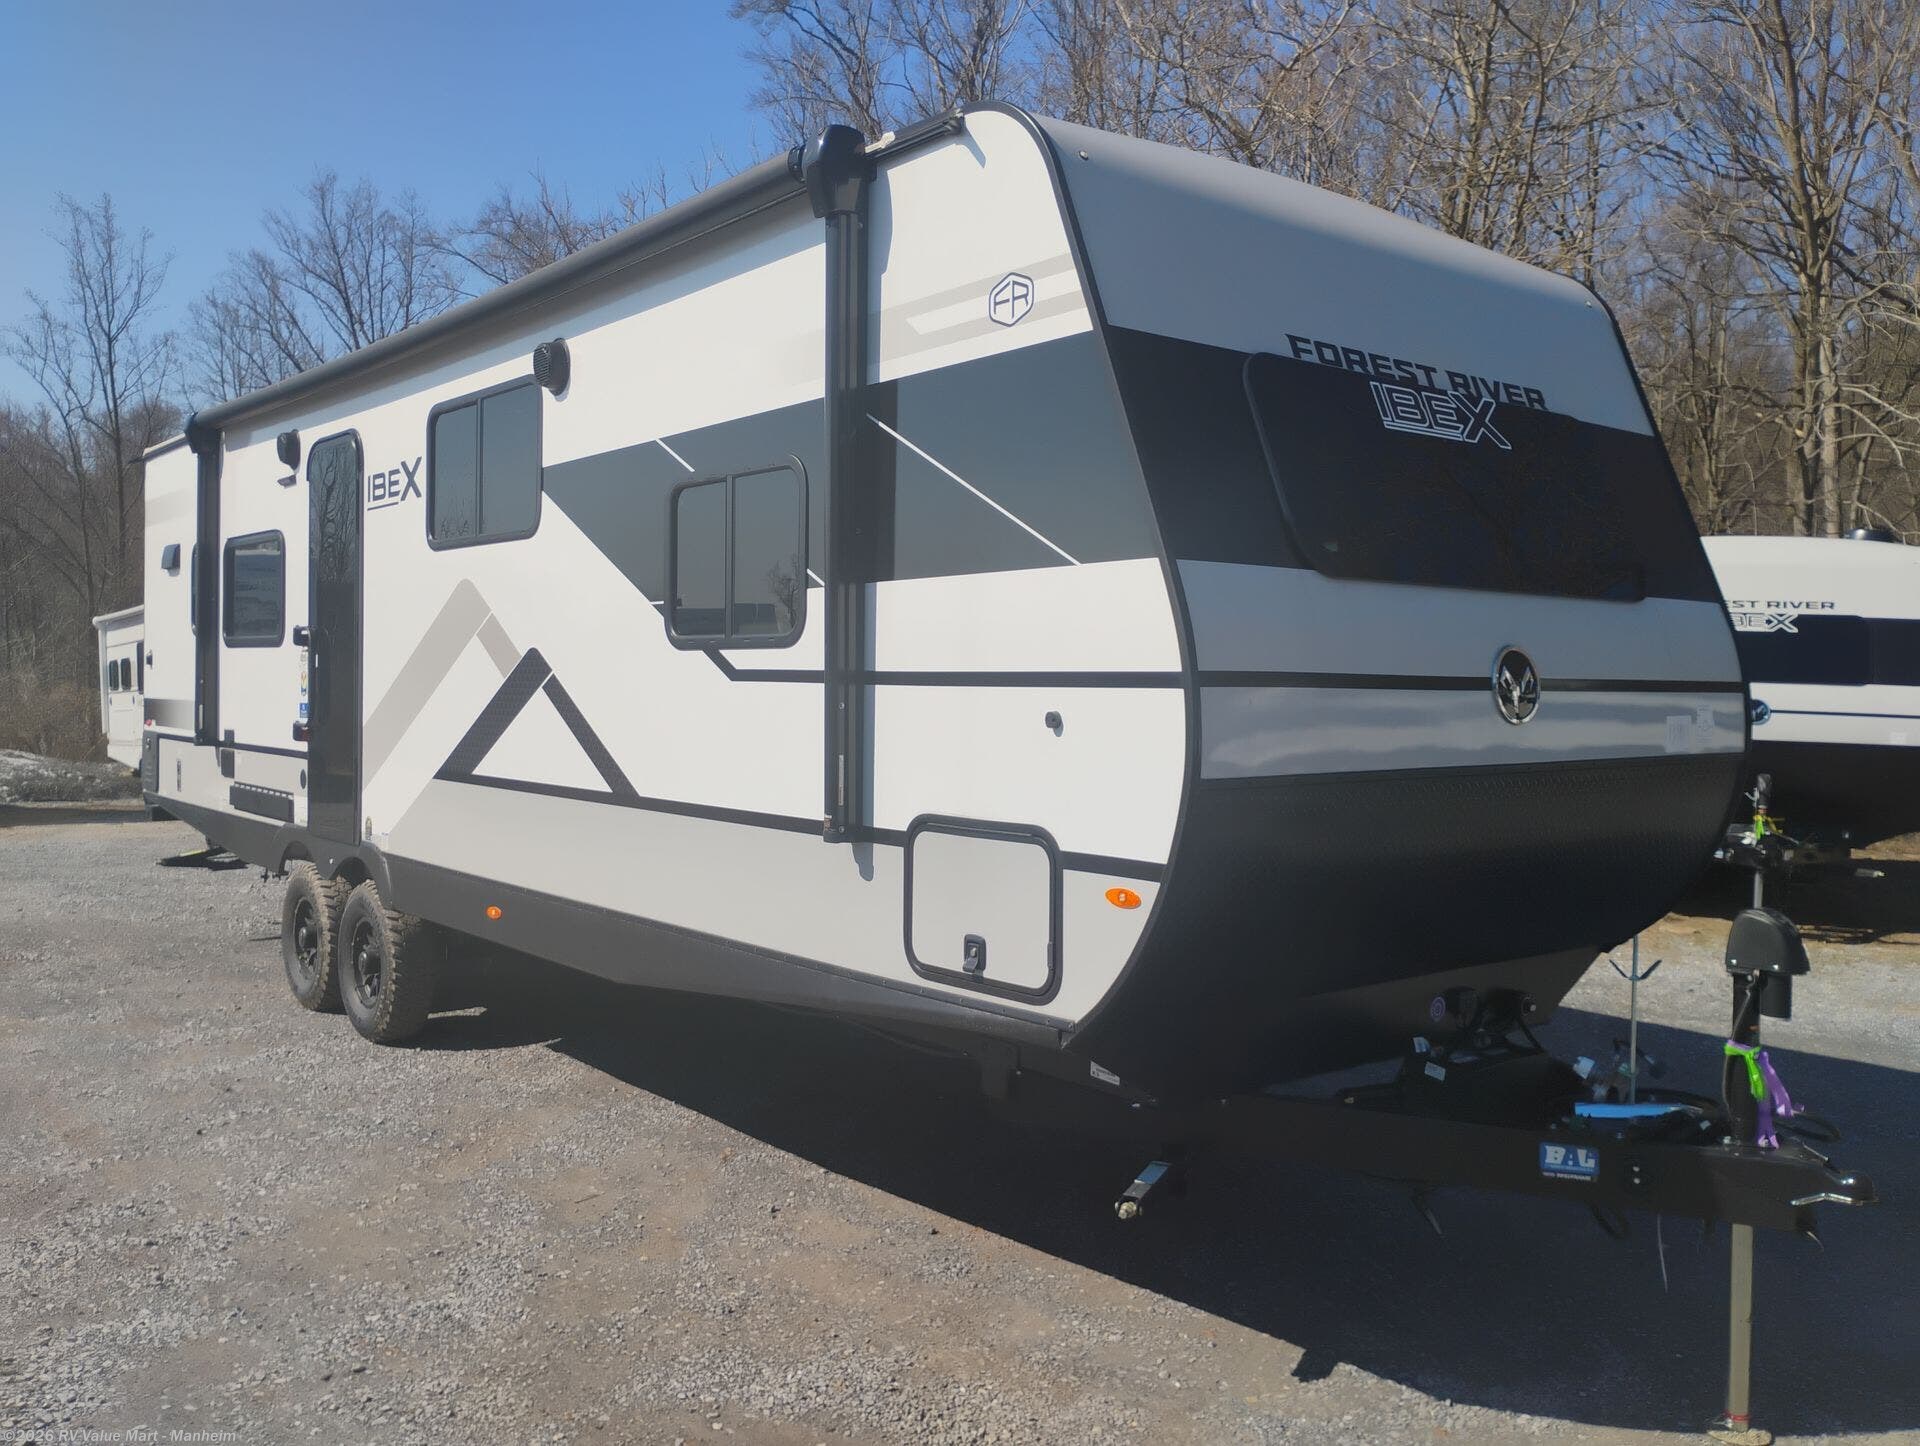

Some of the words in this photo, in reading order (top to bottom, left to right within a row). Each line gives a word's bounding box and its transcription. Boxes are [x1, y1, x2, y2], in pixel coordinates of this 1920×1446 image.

[1285, 333, 1438, 389] FOREST
[1445, 370, 1548, 410] RIVER
[1369, 381, 1512, 450] IBEX
[367, 456, 422, 503] IBEX
[1767, 601, 1834, 609] RIVER
